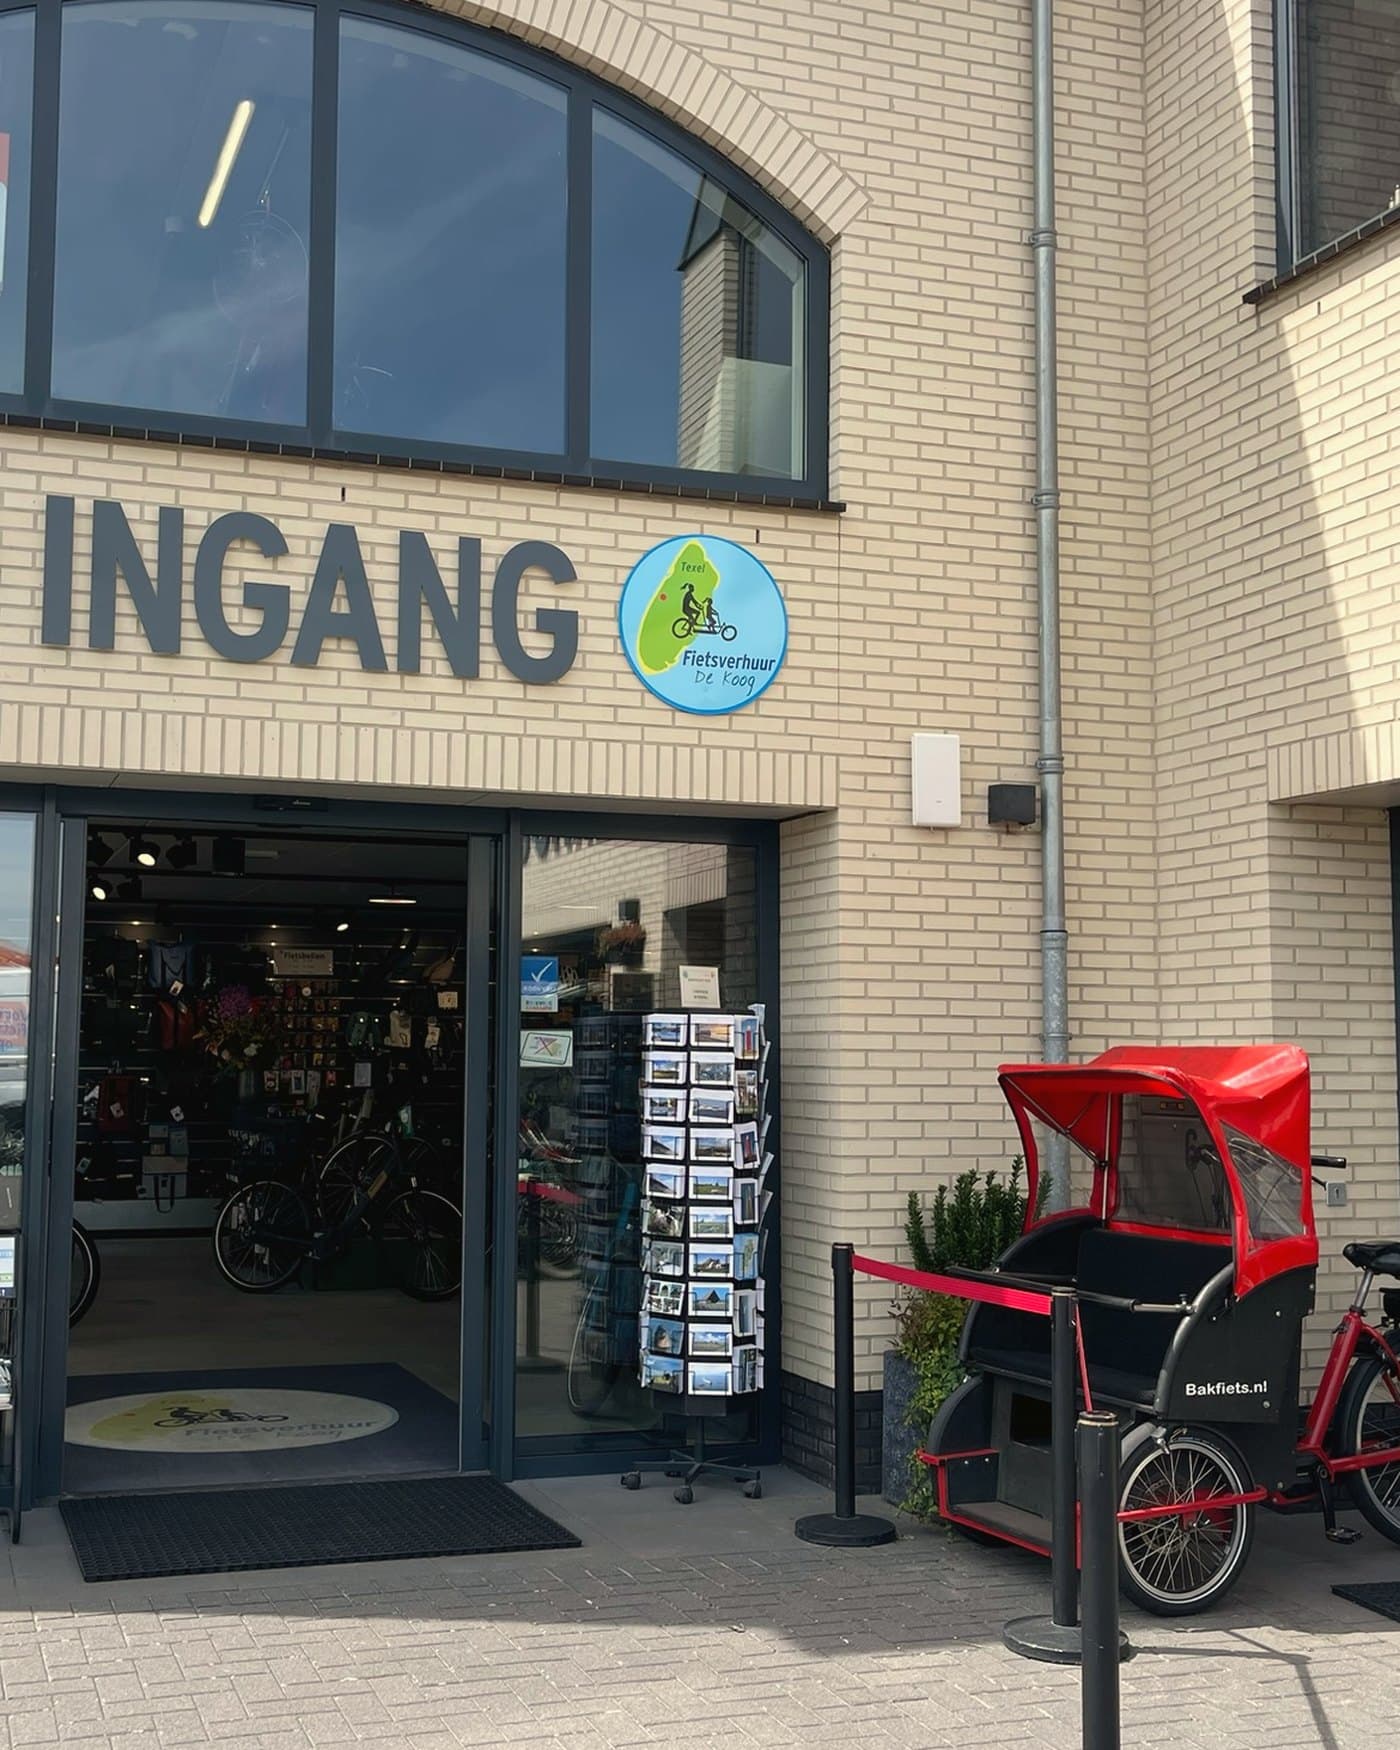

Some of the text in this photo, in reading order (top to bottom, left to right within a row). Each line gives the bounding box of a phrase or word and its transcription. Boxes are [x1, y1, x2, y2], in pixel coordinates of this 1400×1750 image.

[681, 562, 705, 573] Texel
[42, 494, 579, 686] INGANG
[683, 650, 776, 671] Fietsverhuur
[695, 670, 756, 697] De Koog
[1185, 1380, 1268, 1396] Bakfiets.nl
